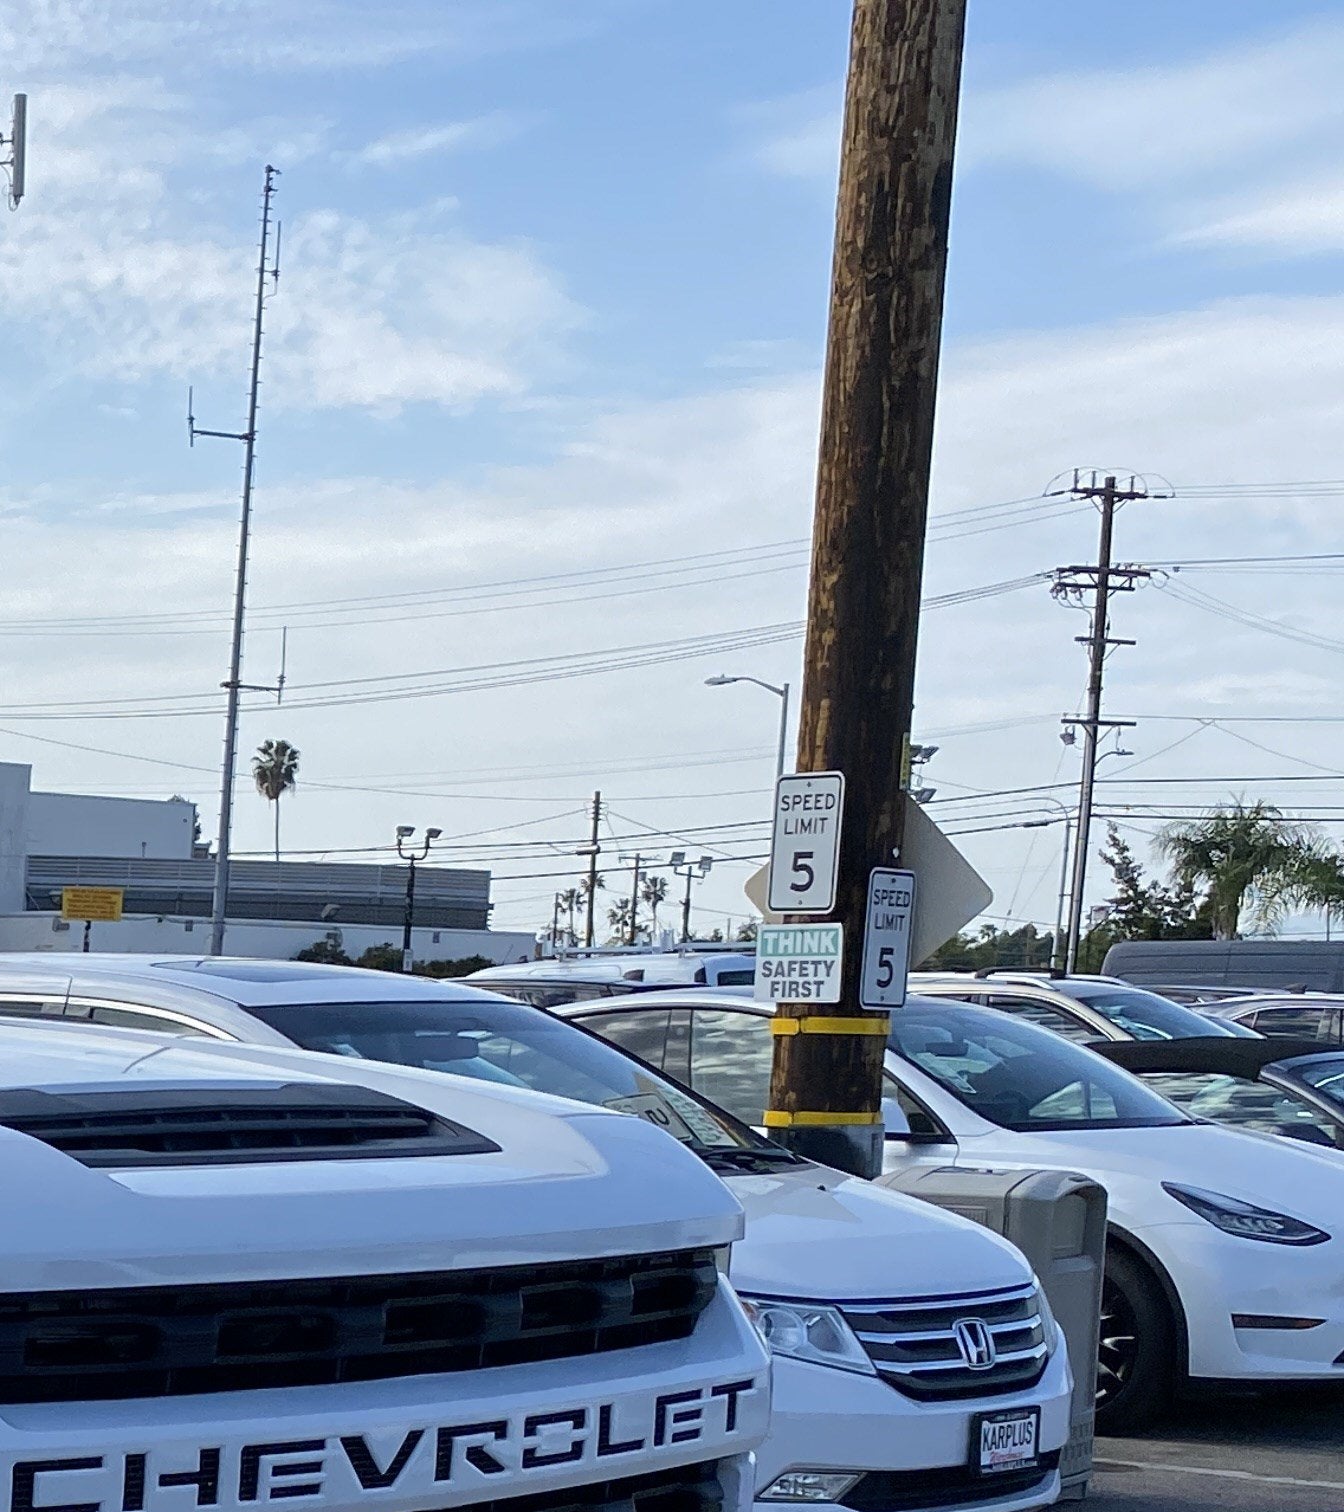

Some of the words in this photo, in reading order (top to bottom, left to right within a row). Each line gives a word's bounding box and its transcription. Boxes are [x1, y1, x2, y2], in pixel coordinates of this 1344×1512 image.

[780, 793, 836, 812] SPEED
[783, 817, 828, 836] LIMIT
[789, 850, 814, 892] 5
[873, 888, 911, 908] SPEED
[874, 914, 906, 931] LIMIT
[764, 930, 837, 954] THINK
[761, 959, 836, 978] SAFETY
[876, 947, 894, 988] 5
[769, 980, 825, 998] FIRST
[982, 1421, 1034, 1452] KARPLUS
